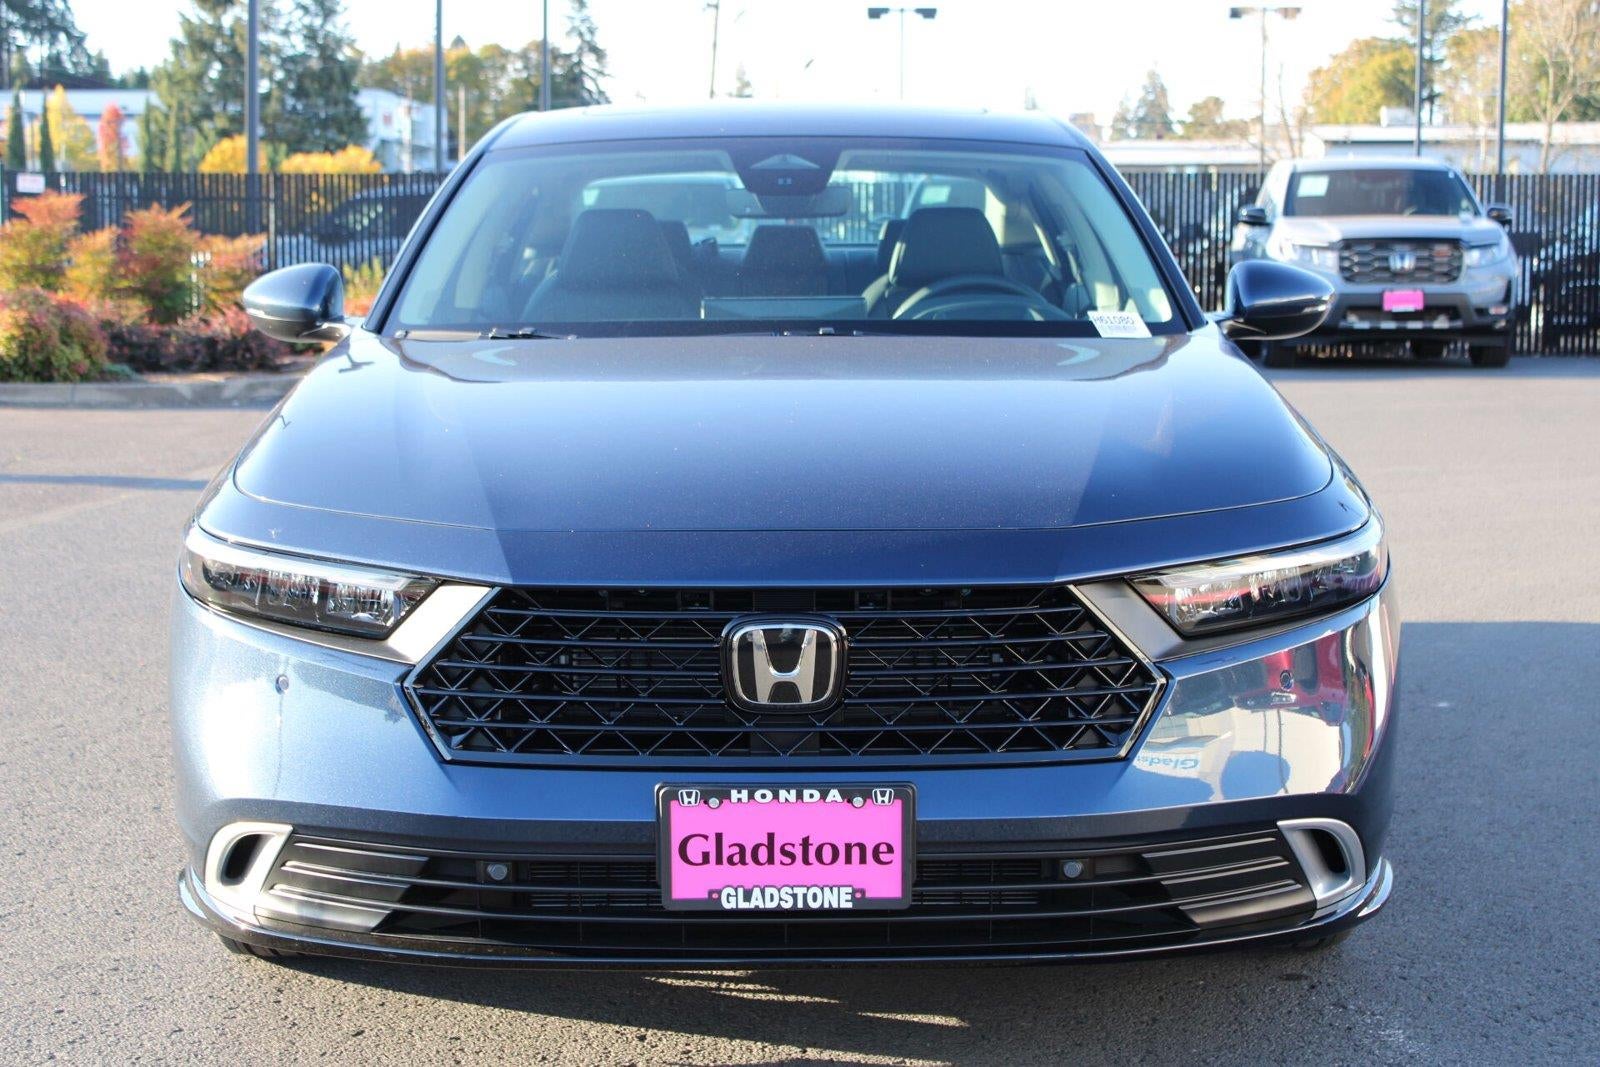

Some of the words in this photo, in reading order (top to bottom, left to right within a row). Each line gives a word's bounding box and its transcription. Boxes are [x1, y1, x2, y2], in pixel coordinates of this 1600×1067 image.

[730, 788, 844, 804] HONDA
[677, 831, 895, 867] Gladstone
[720, 885, 853, 909] GLADSTONE
